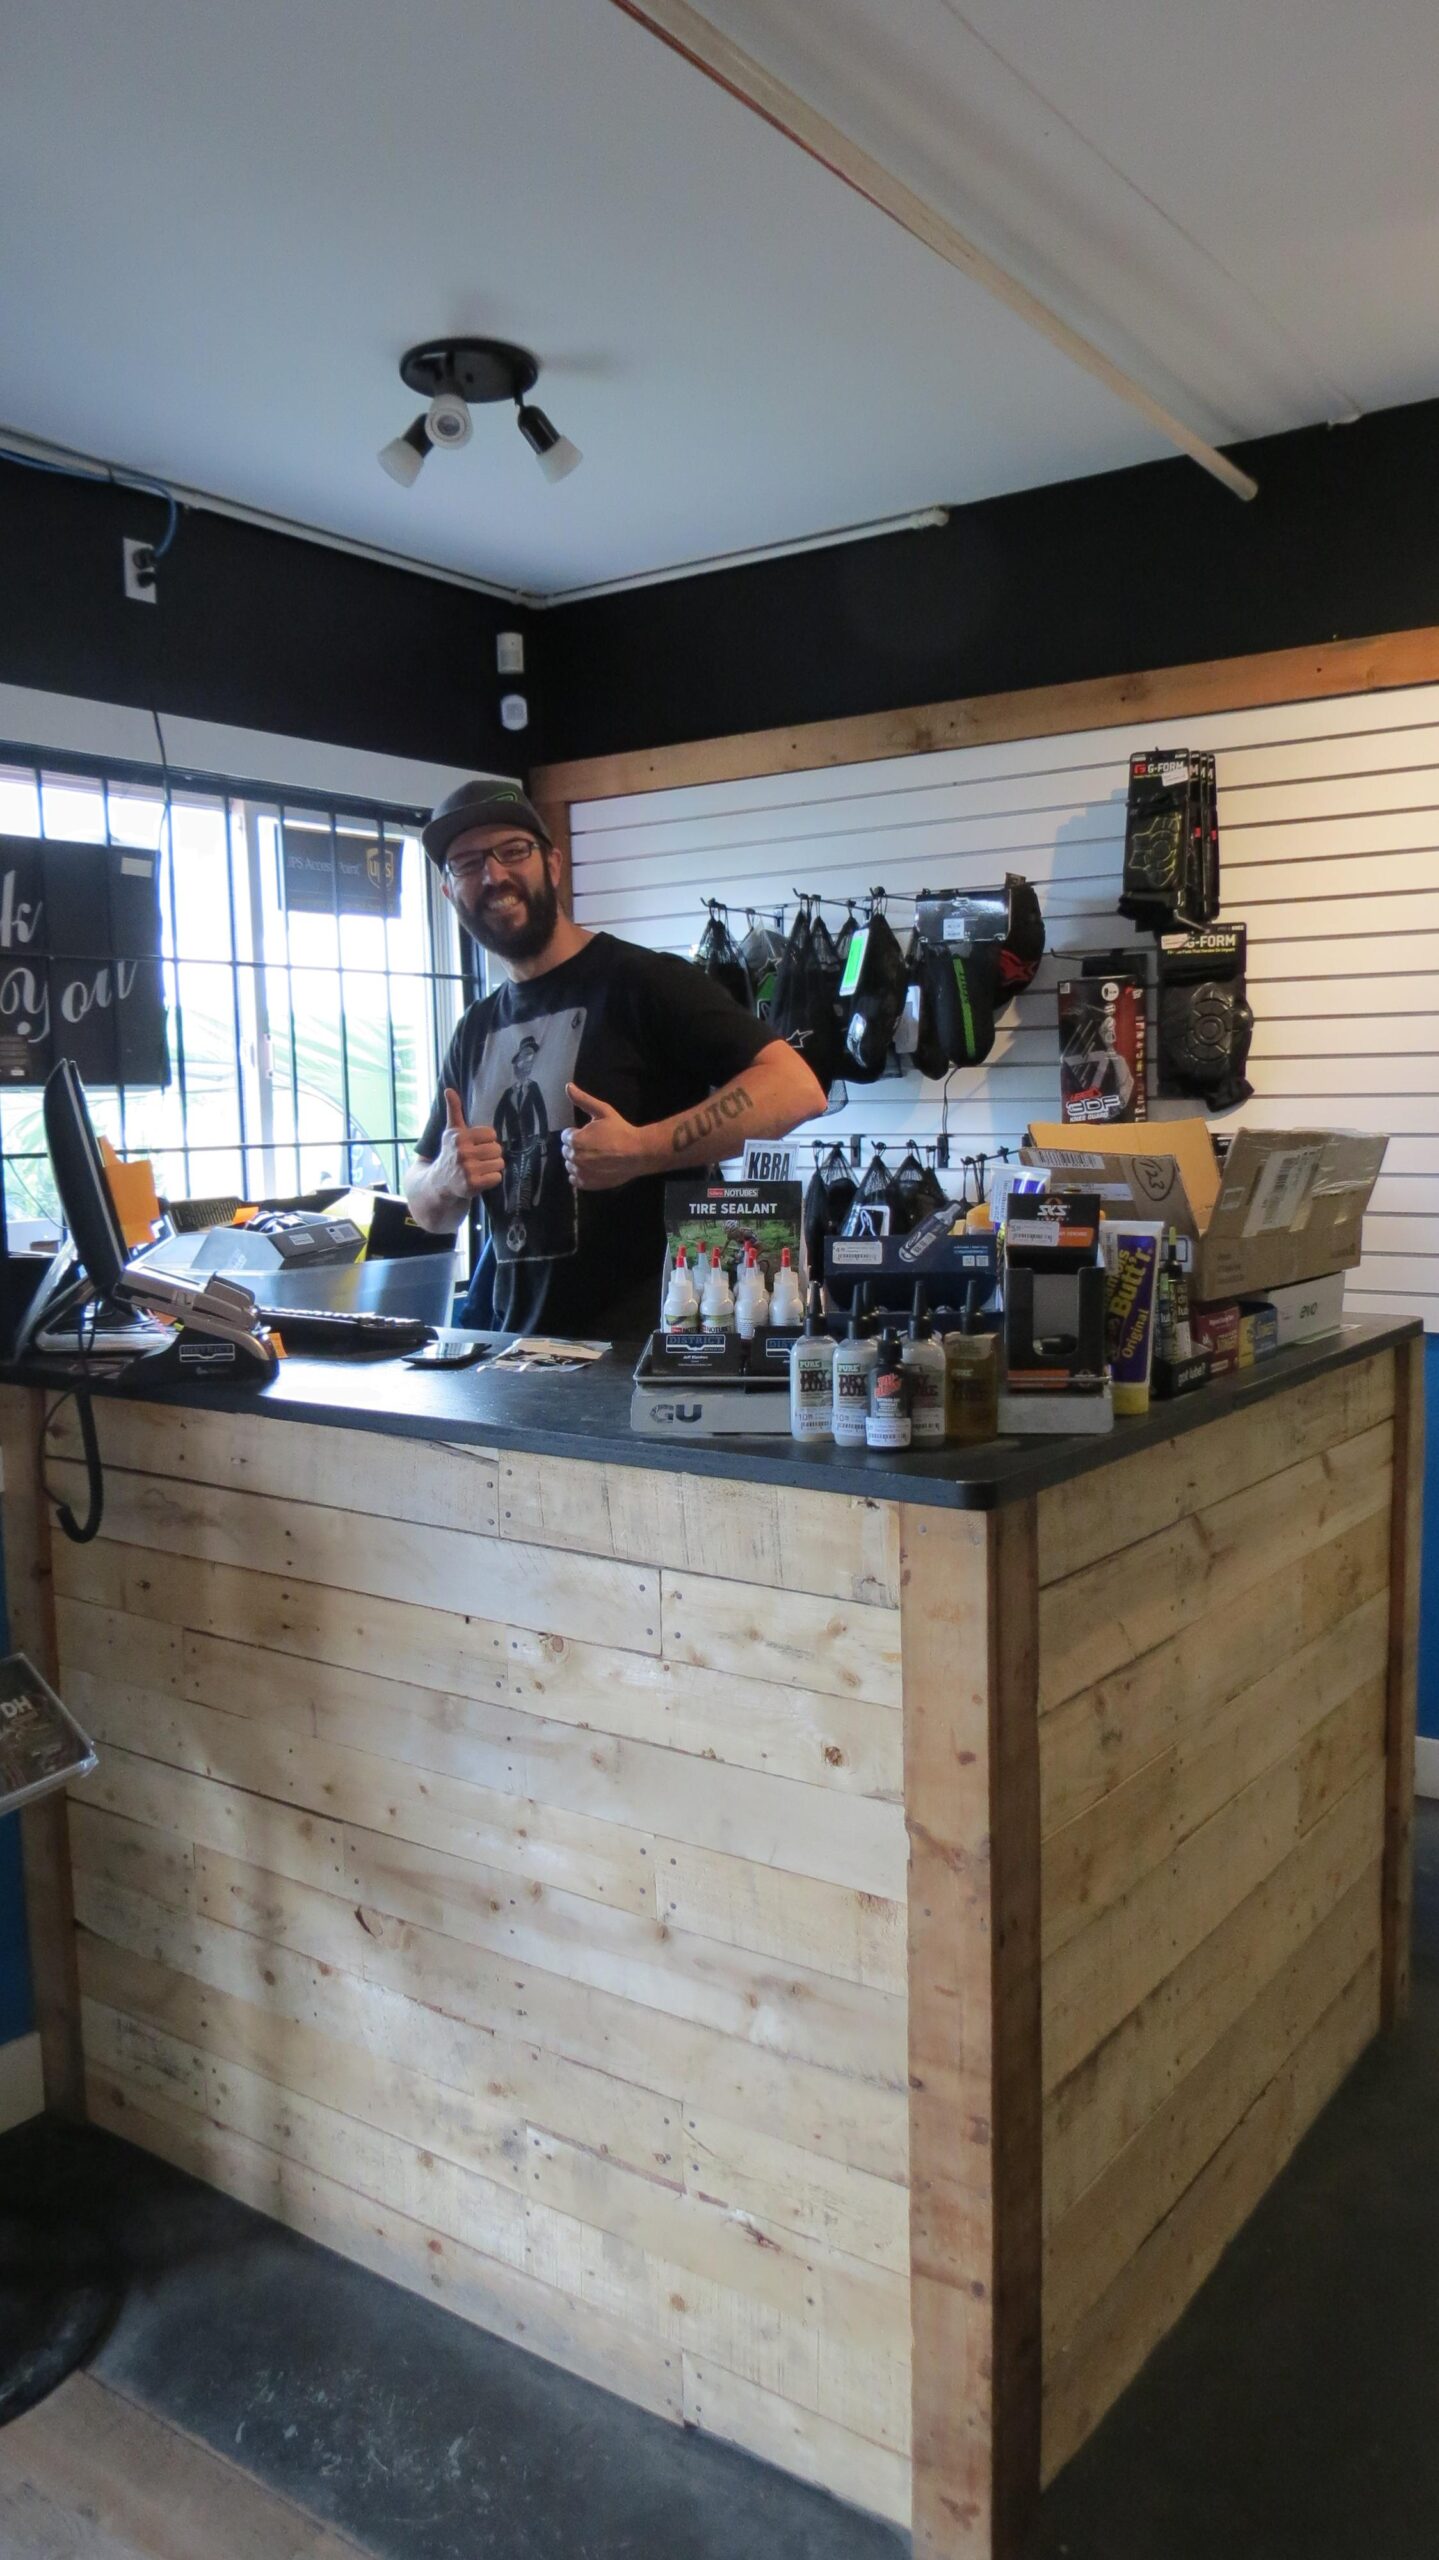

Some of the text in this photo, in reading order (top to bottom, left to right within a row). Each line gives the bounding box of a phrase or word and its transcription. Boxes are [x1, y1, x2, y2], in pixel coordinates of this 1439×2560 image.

[672, 1087, 754, 1153] CLUTCH
[747, 1152, 791, 1181] KBRA
[724, 1188, 758, 1197] NOTUBES
[689, 1203, 778, 1215] TIRE SEALANT
[1037, 1204, 1068, 1217] SKS
[1121, 1308, 1149, 1359] Original
[668, 1335, 722, 1345] DISTRICT
[800, 1360, 821, 1368] PURE
[838, 1364, 860, 1372] PURE
[650, 1404, 702, 1424] GU
